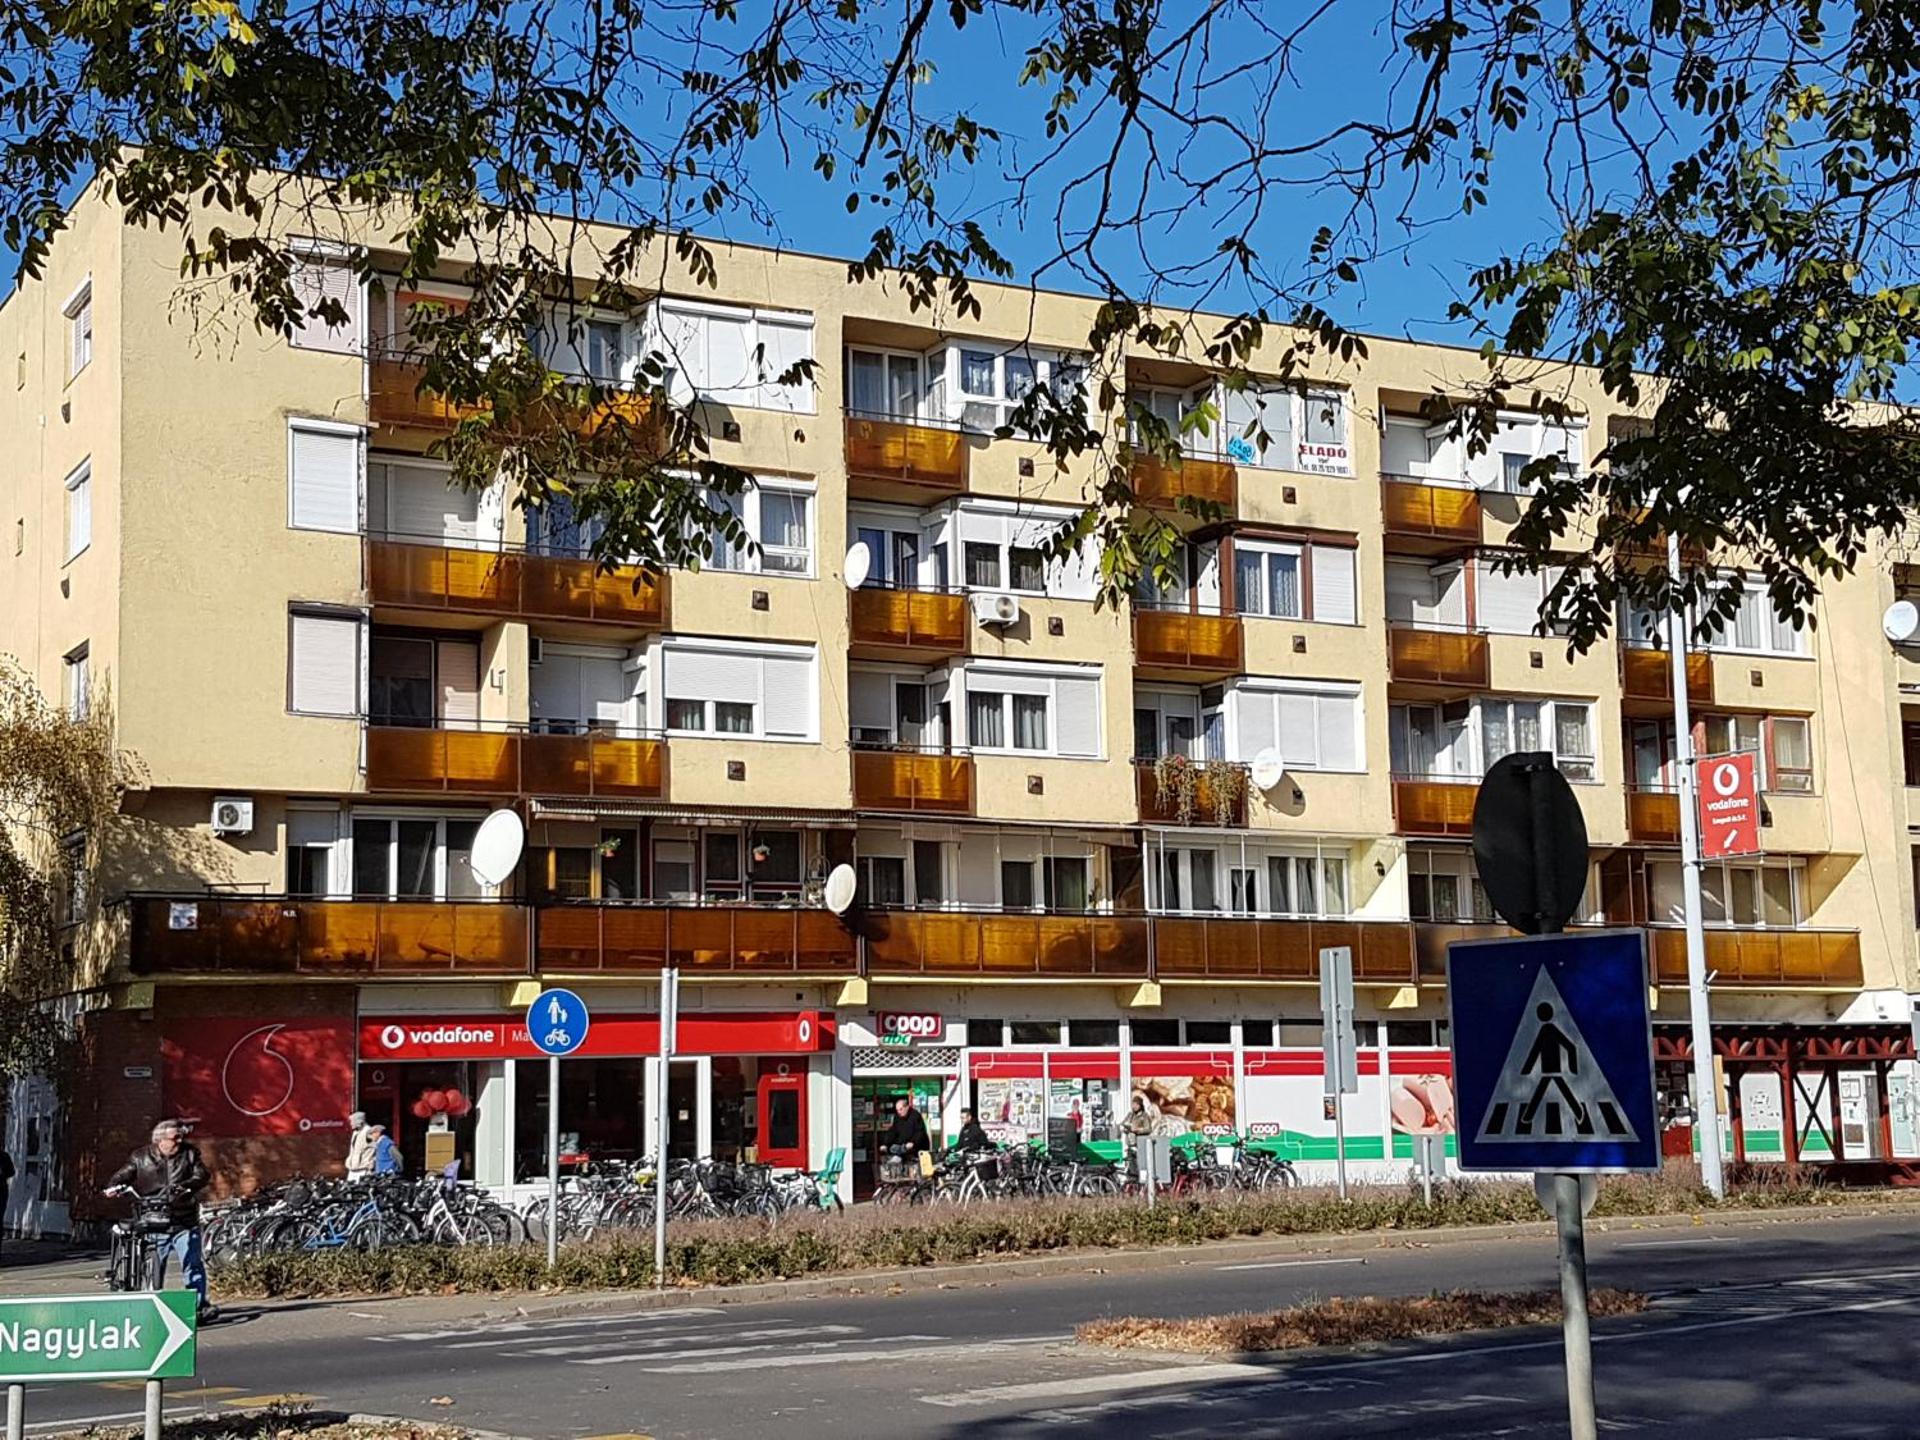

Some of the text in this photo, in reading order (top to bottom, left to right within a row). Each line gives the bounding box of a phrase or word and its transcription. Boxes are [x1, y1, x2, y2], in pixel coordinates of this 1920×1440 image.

[1707, 798, 1749, 811] vodafone
[884, 1015, 936, 1035] coop
[410, 1026, 530, 1043] vodafone Ma
[1251, 1124, 1278, 1136] coop
[0, 1318, 142, 1359] Nagylak
